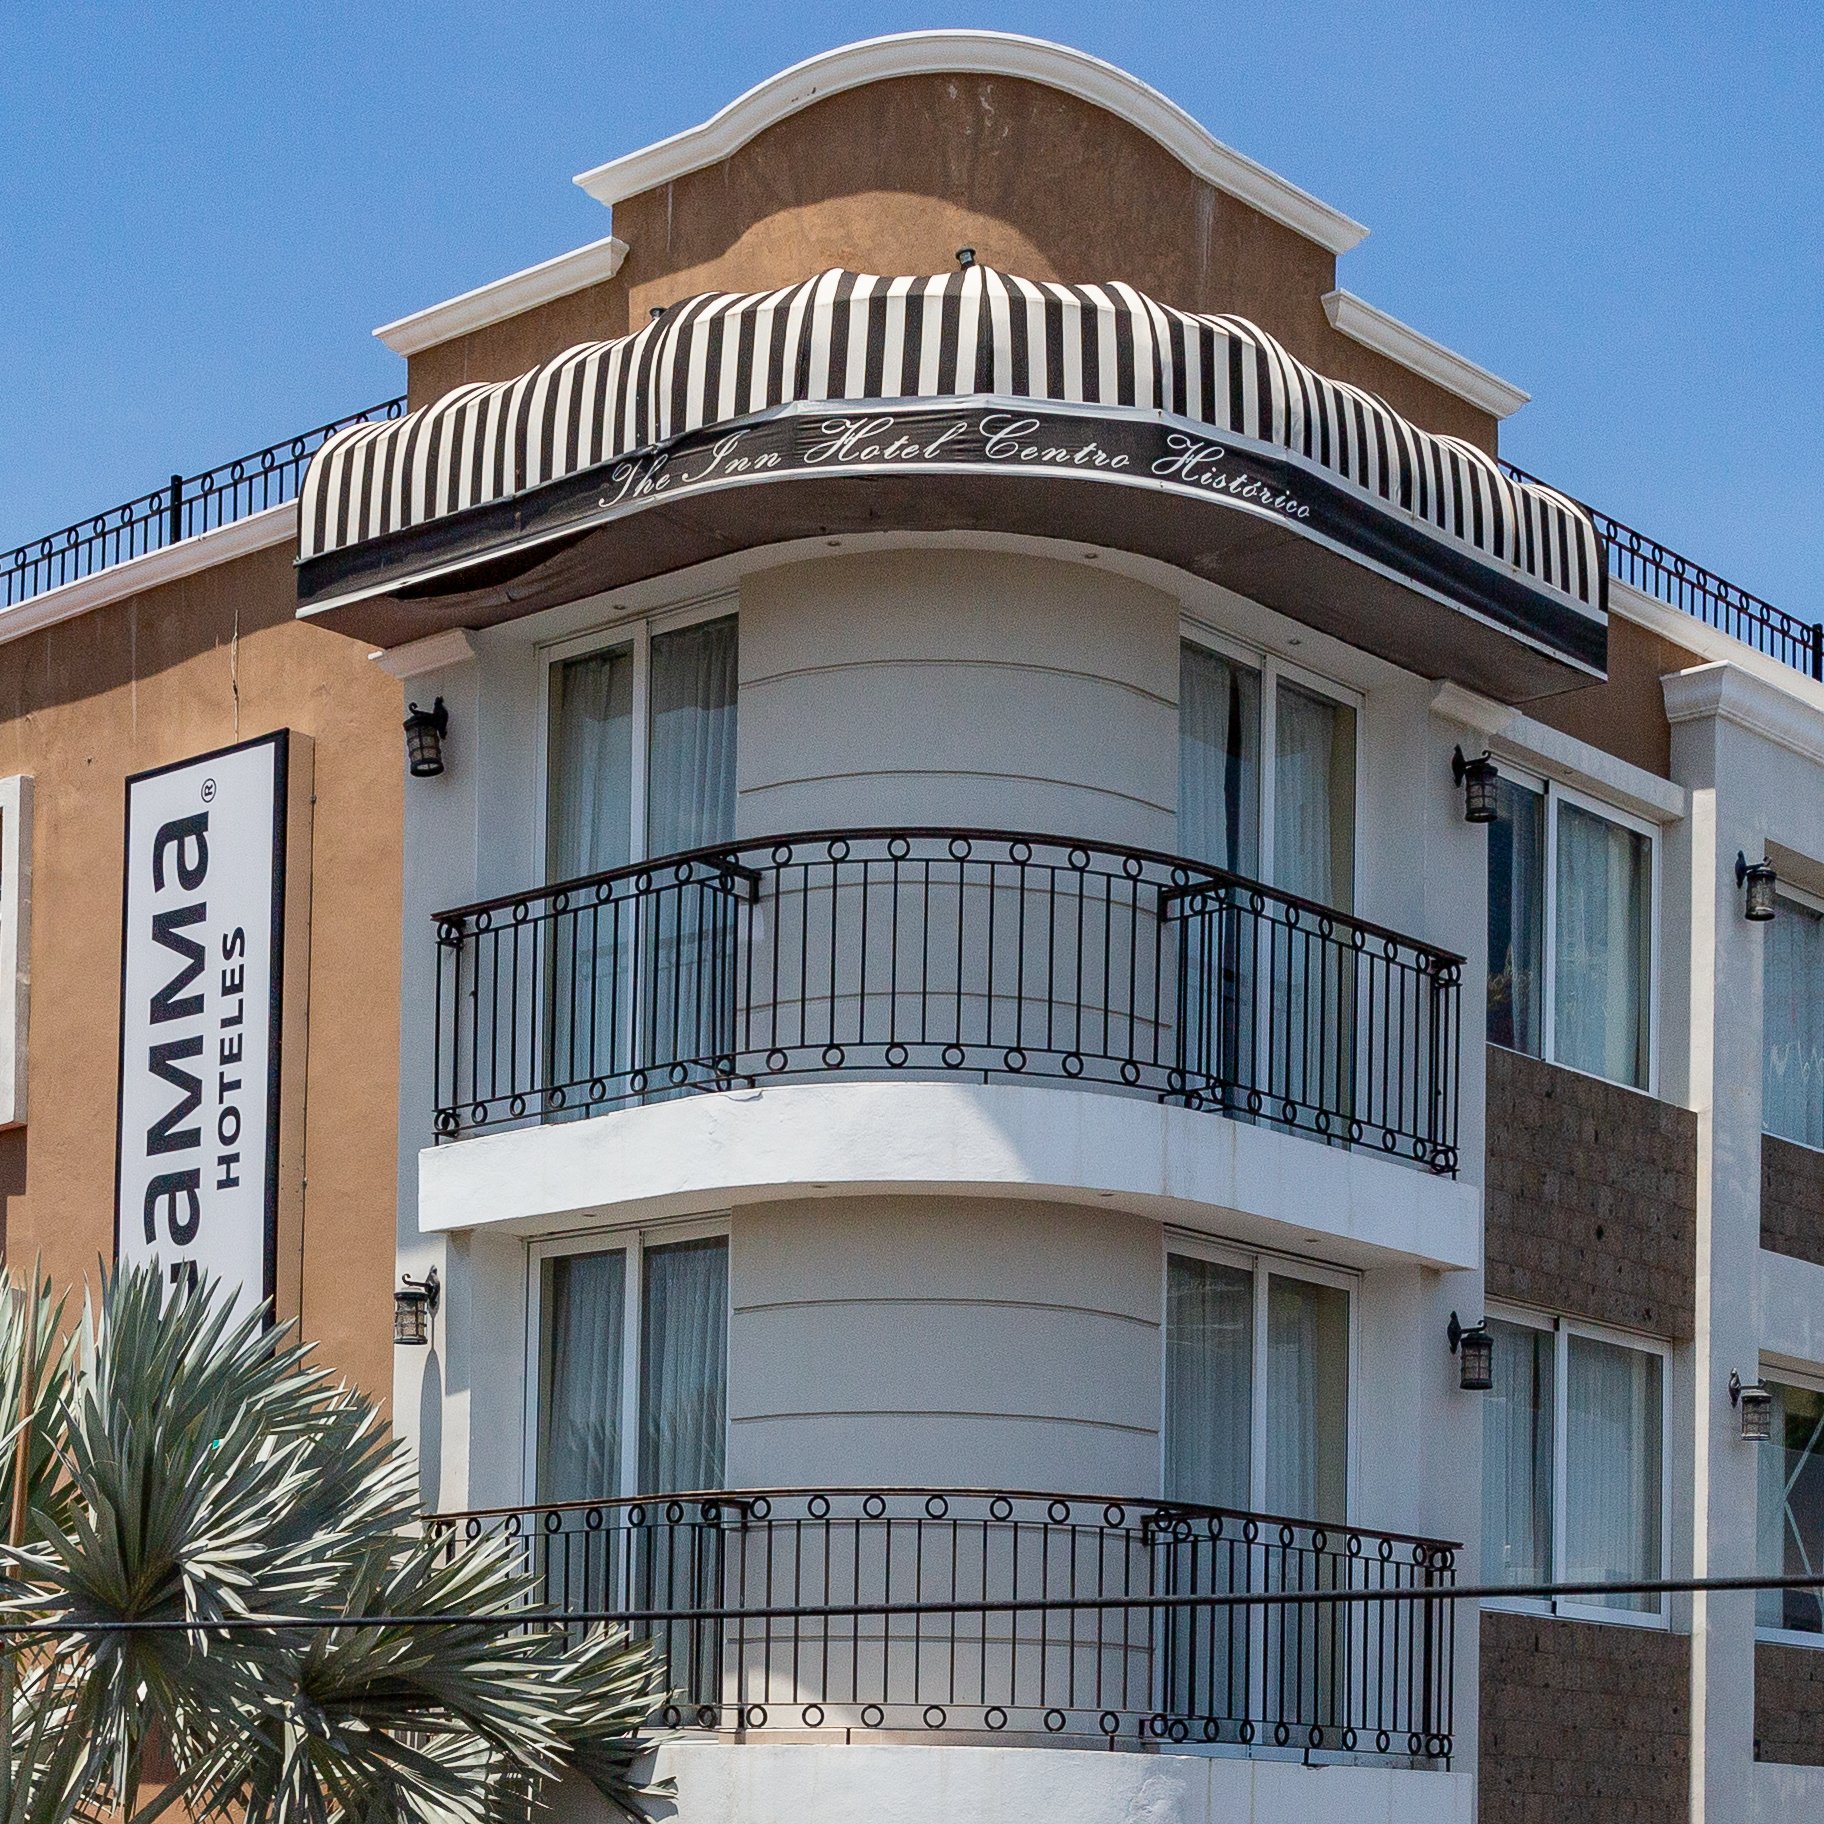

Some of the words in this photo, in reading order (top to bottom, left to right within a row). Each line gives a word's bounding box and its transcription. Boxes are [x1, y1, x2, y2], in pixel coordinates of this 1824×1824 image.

[598, 453, 672, 508] The
[681, 429, 783, 483] Inn
[803, 416, 968, 464] Hotel
[979, 413, 1130, 469] Centro
[1151, 434, 1311, 519] Histórico
[215, 925, 247, 1191] HOTELES
